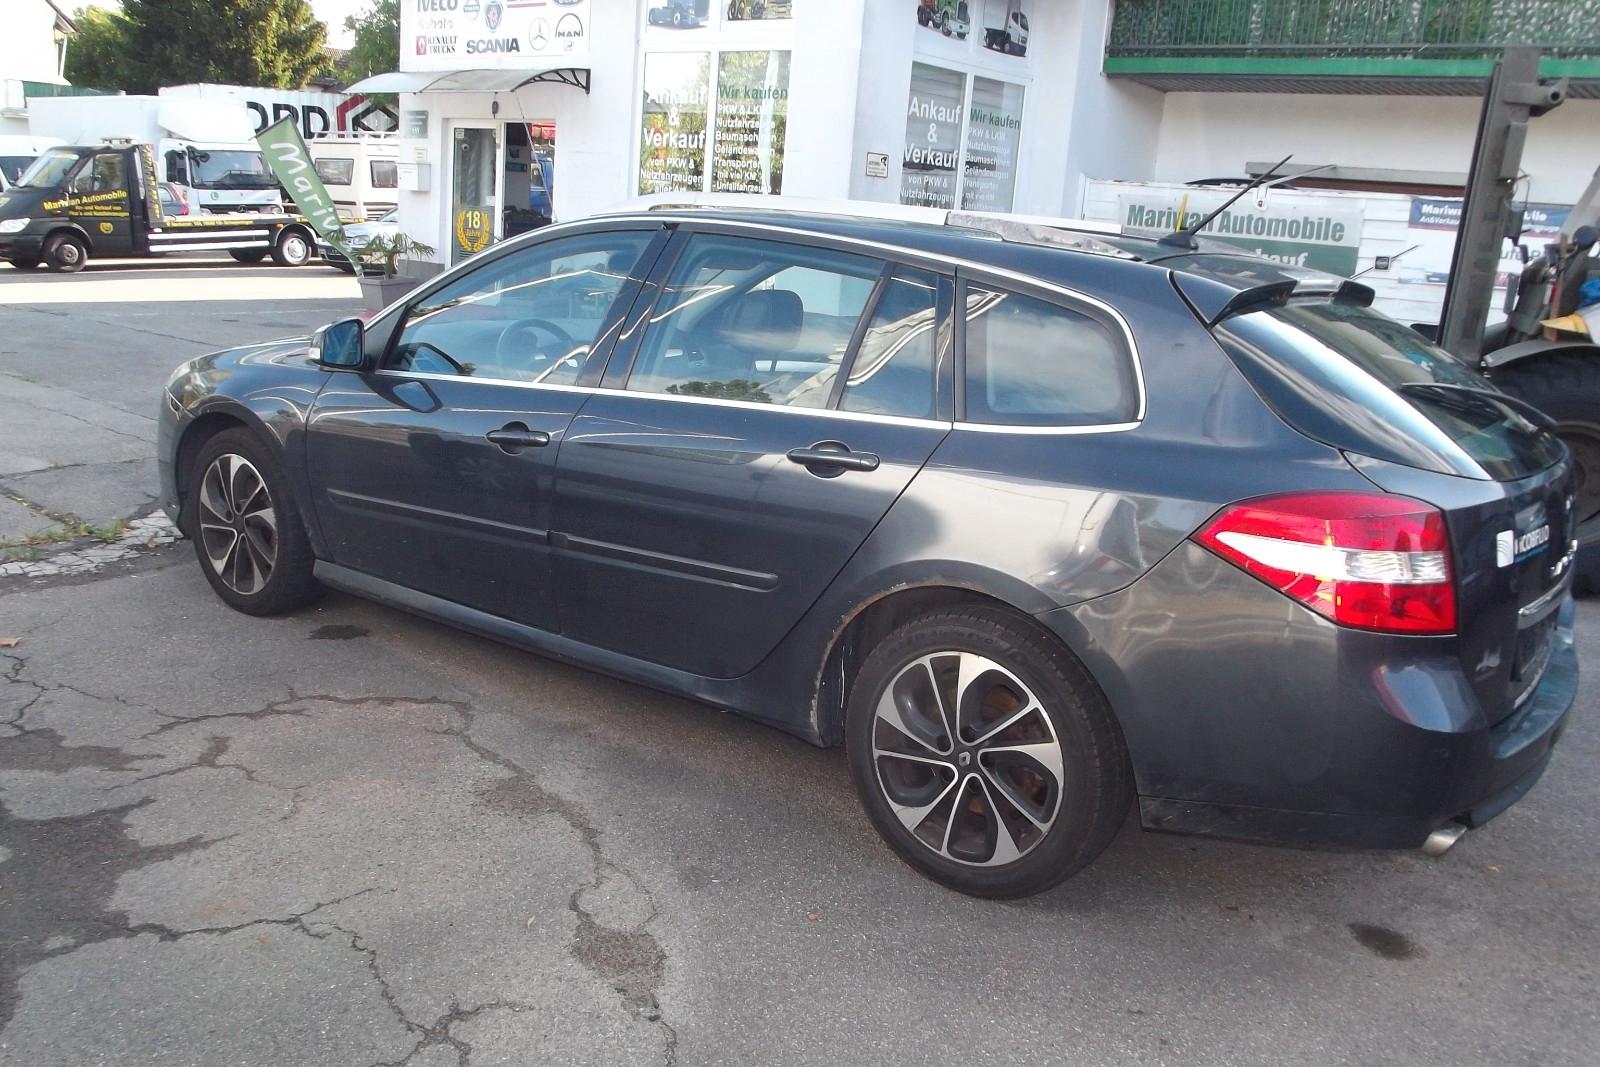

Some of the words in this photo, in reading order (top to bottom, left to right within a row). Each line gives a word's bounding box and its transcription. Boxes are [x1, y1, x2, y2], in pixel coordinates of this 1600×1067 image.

[417, 0, 458, 12] IVECO
[428, 36, 457, 44] RENAULT
[467, 38, 520, 54] SCANIA
[430, 45, 456, 54] TRUCKS
[719, 84, 738, 99] Wir
[743, 85, 788, 100] kaufen
[717, 104, 738, 115] PKW
[909, 96, 961, 124] Ankauf
[247, 101, 331, 139] DPD
[668, 106, 680, 127] &
[971, 108, 987, 123] Wir
[989, 112, 1020, 129] kaufen
[715, 118, 776, 129] Nutzfahrzee
[643, 127, 706, 149] Verkauf
[715, 130, 777, 142] Baumaschn
[927, 122, 938, 143] &
[968, 127, 984, 137] PKW
[714, 144, 775, 157] Geländewan
[903, 143, 959, 169] Verkauf
[651, 158, 665, 167] von
[666, 157, 687, 168] PKW
[689, 159, 695, 169] &
[640, 168, 703, 185] Nutzfahrzeugen
[908, 175, 922, 184] von
[923, 175, 941, 187] PKW
[942, 177, 948, 188] &
[82, 190, 127, 203] Automobile
[899, 187, 954, 204] Nutzfahrzeugen
[1422, 204, 1462, 216] Mariw
[466, 210, 481, 229] 18
[1127, 204, 1214, 232] Mariwan
[1217, 211, 1345, 242] Automobile
[1419, 216, 1460, 225] An&Verkau
[465, 229, 481, 237] Jahre
